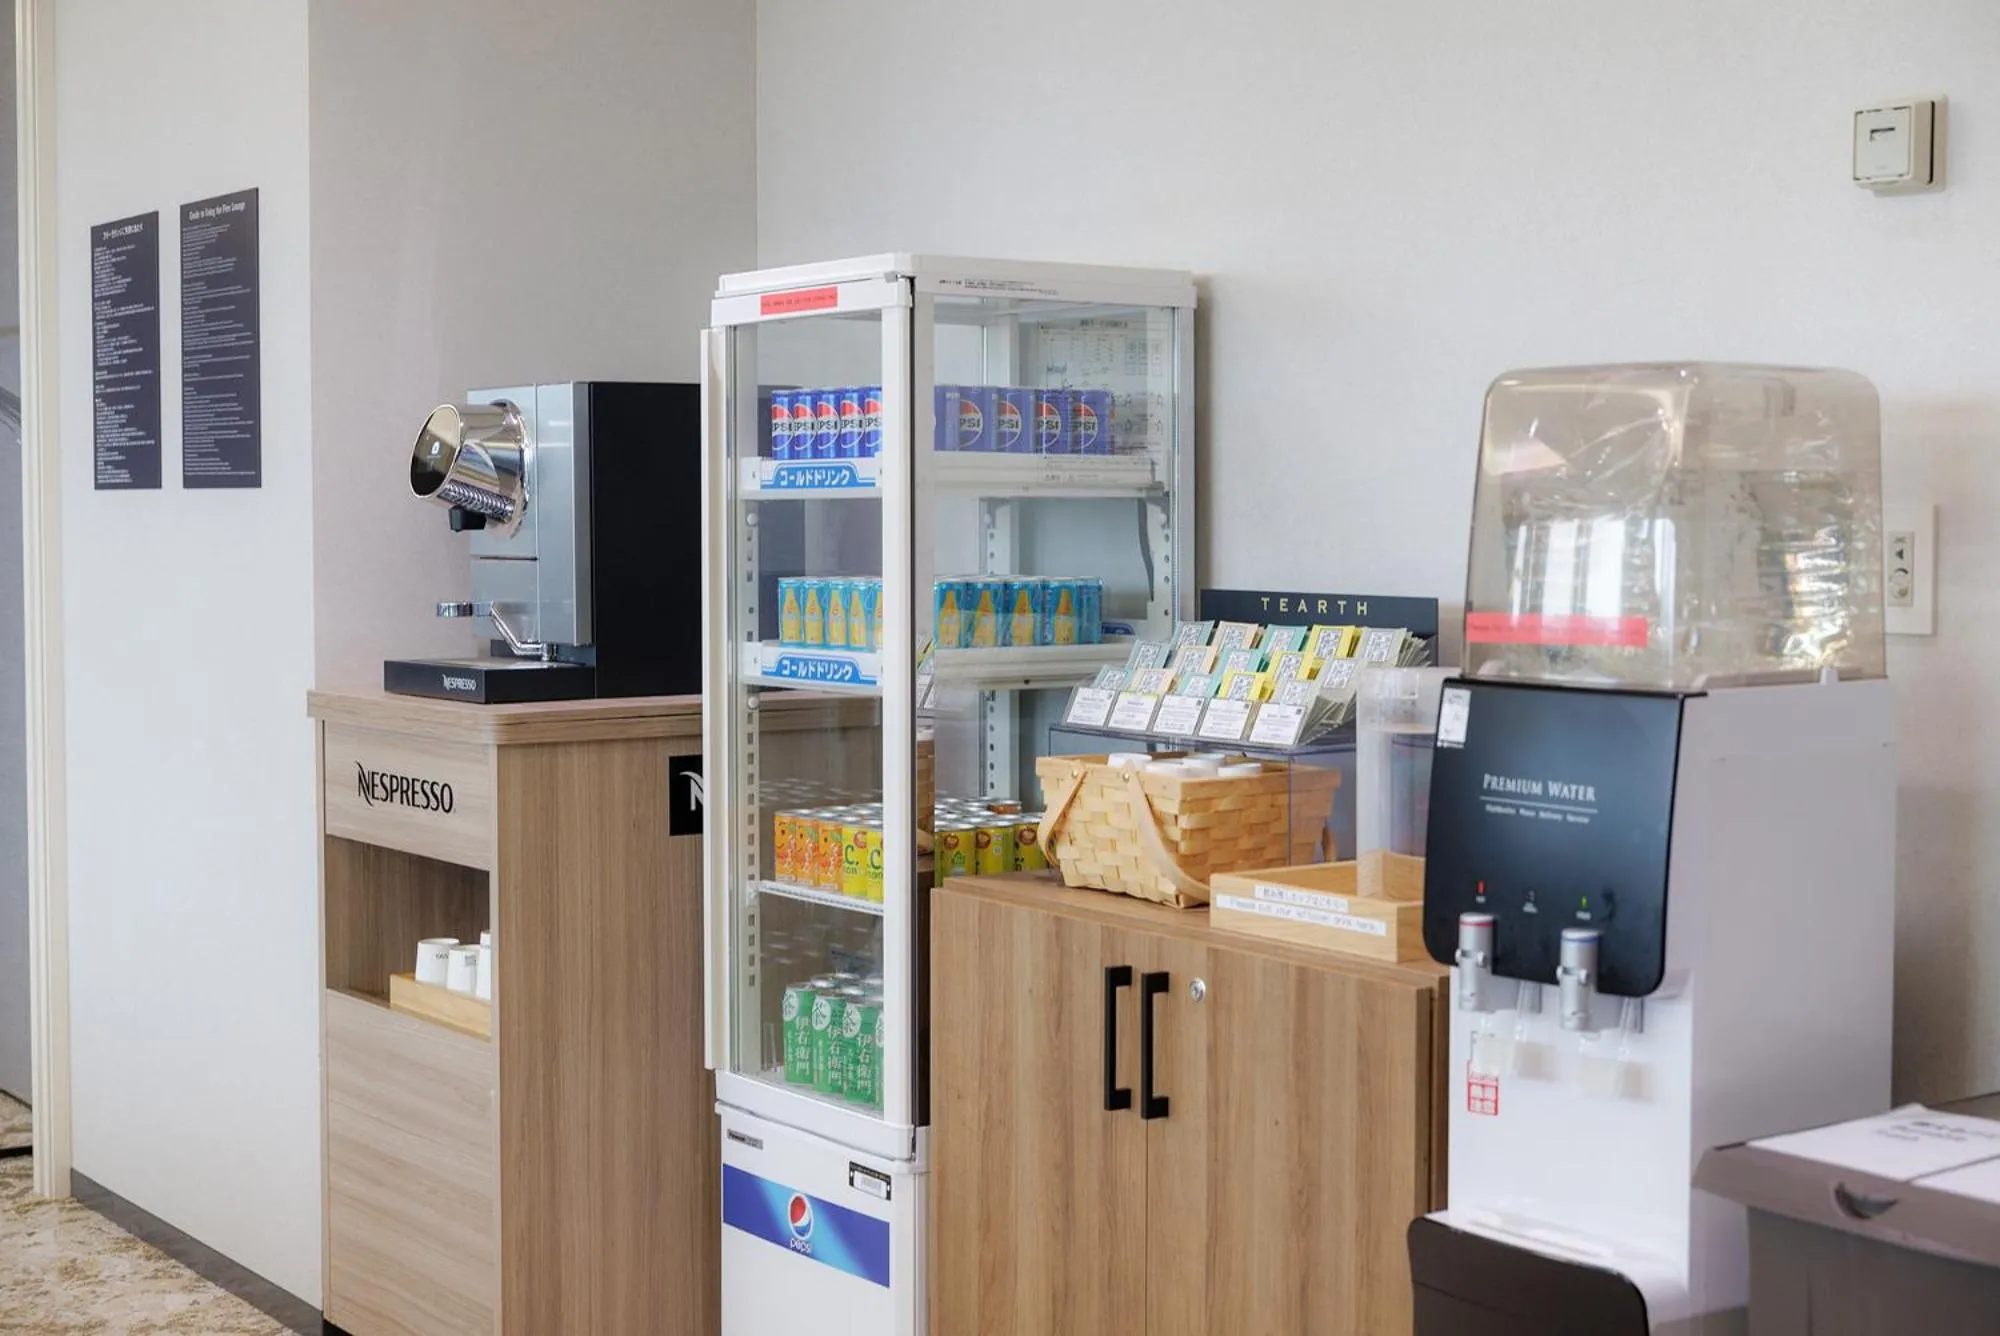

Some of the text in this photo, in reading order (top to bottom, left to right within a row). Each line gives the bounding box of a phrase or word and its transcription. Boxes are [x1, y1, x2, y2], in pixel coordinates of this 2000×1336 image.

[780, 468, 850, 486] コールドドリンク
[1261, 597, 1368, 615] TEARTH
[781, 659, 853, 681] コールドドリンク
[442, 674, 477, 691] NESPRESSO
[355, 760, 453, 814] NESPRESSO
[1483, 773, 1543, 796] PREMIUM
